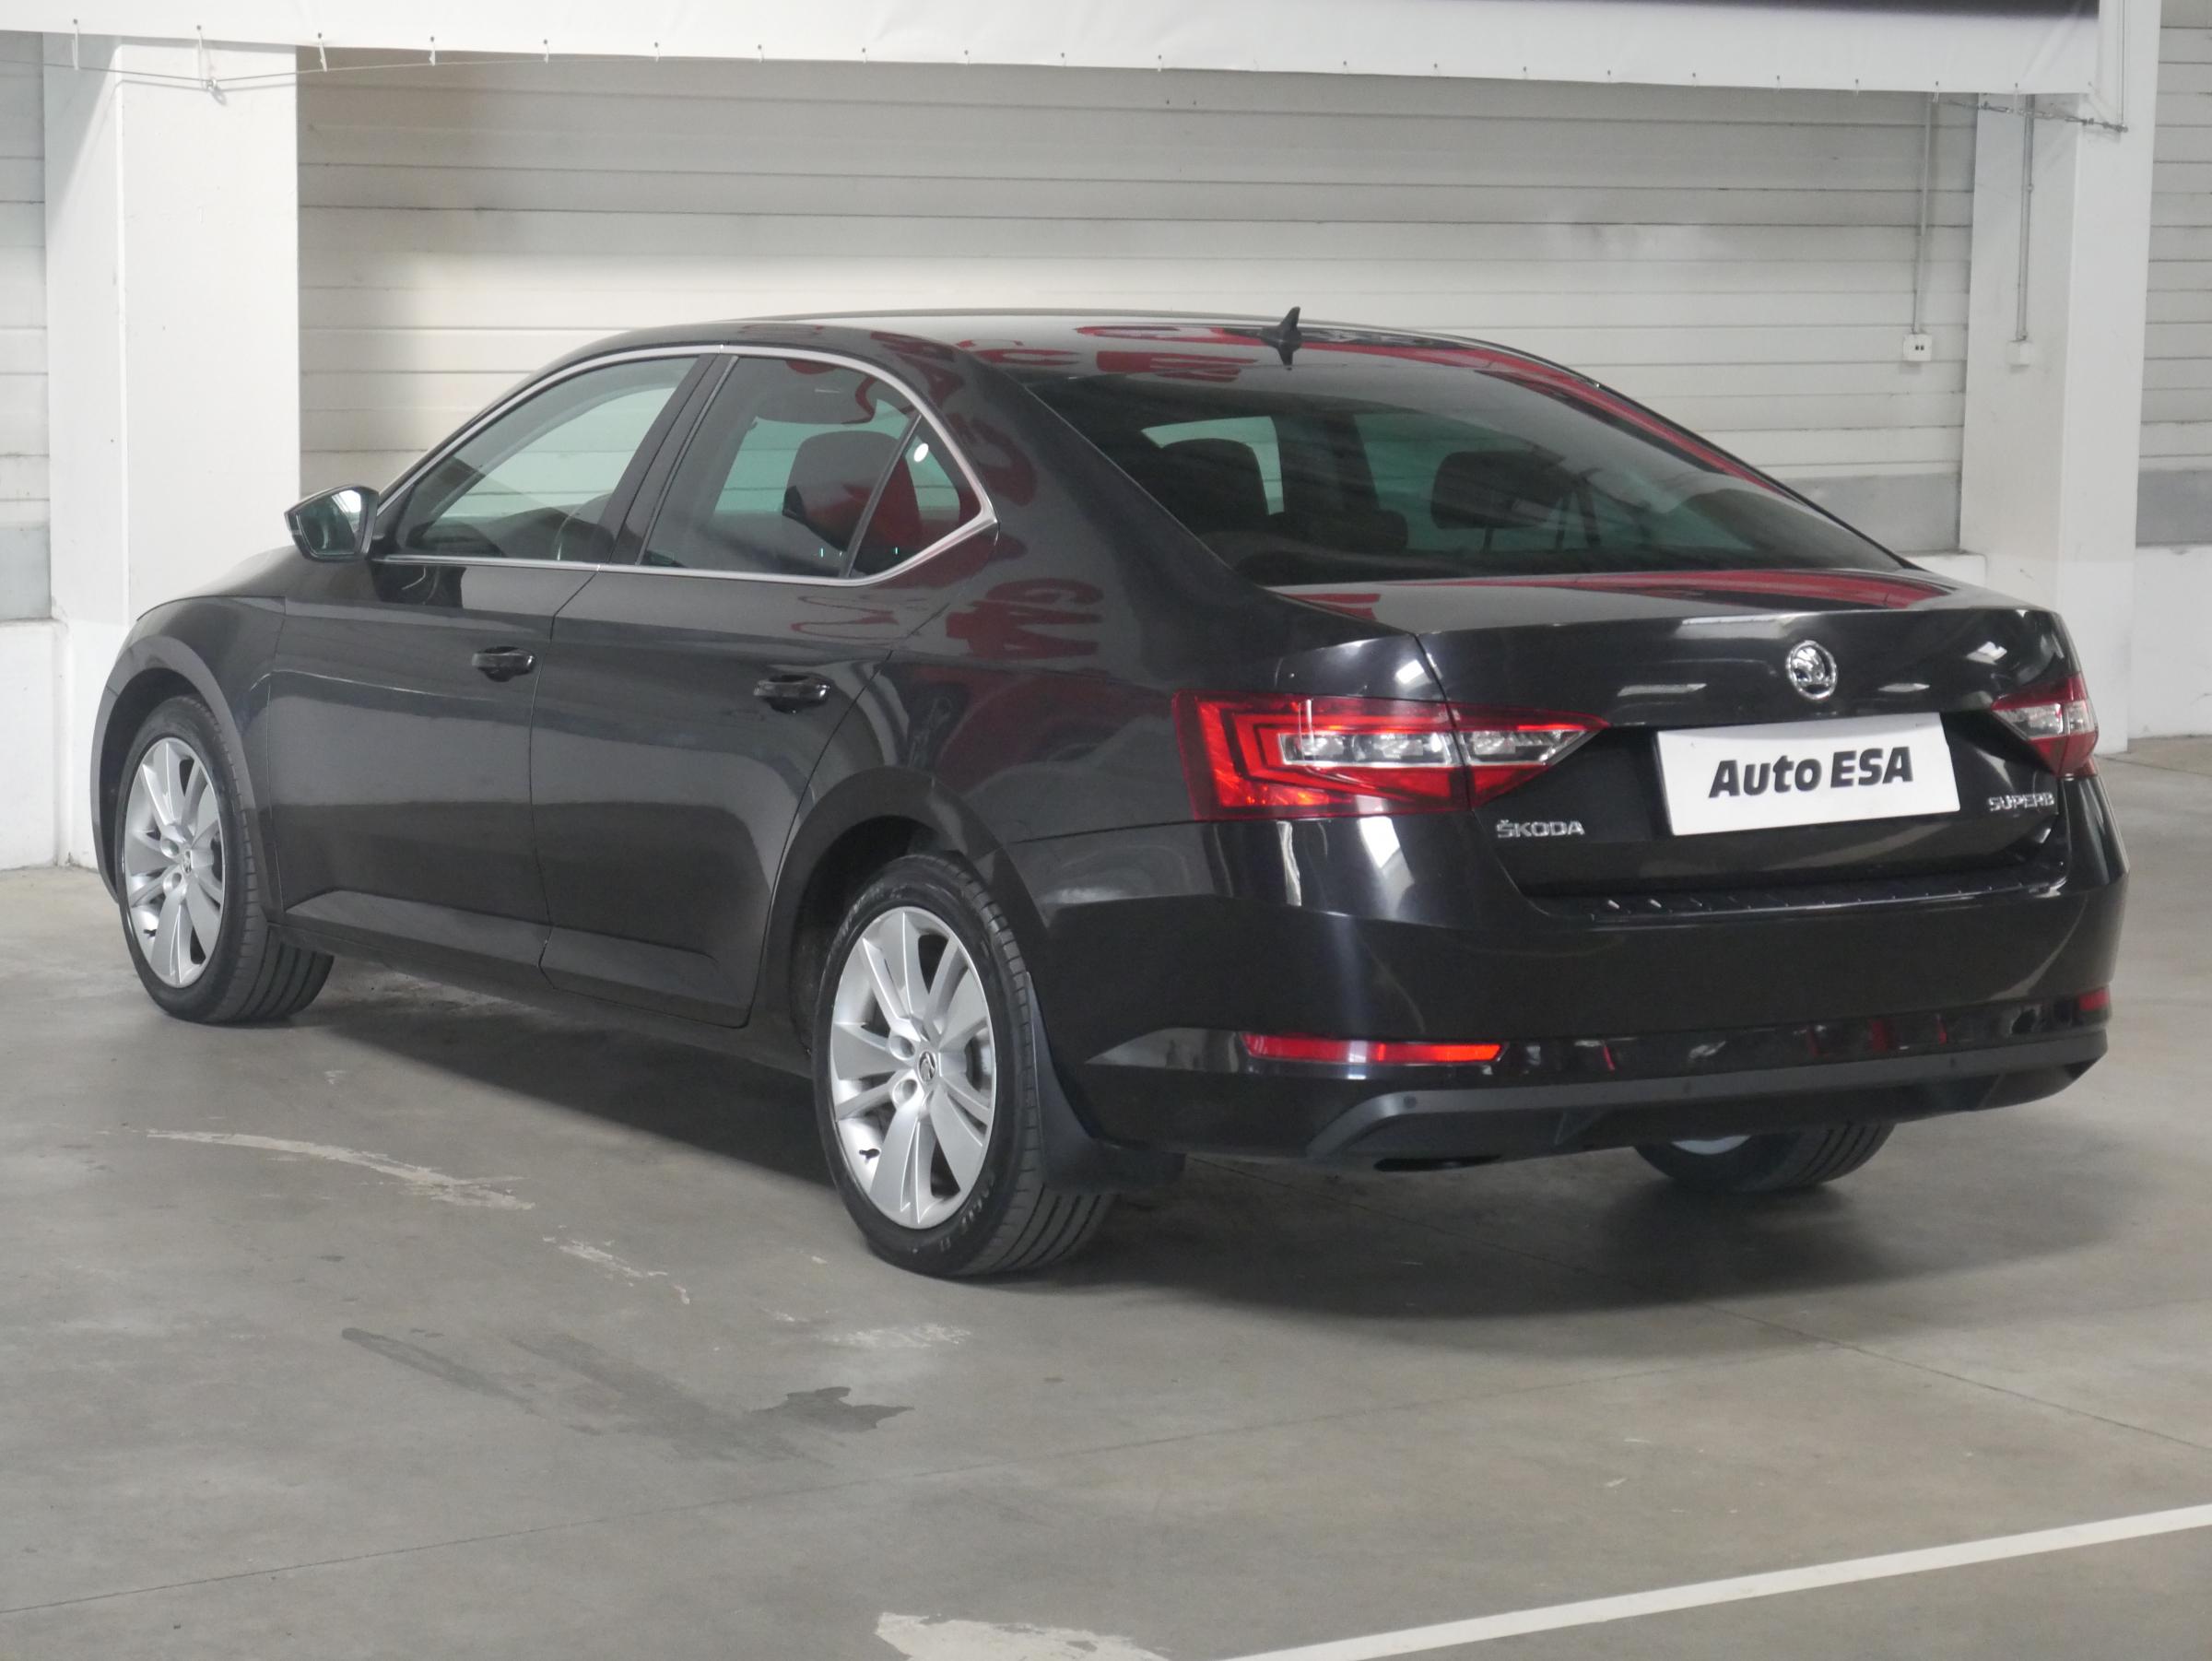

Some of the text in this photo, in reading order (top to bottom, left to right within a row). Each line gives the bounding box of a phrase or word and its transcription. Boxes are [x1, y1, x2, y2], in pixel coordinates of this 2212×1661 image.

[1708, 746, 1913, 798] Auto ESA
[1988, 793, 2054, 811] SUPERB
[1496, 819, 1585, 838] ŠKODA
